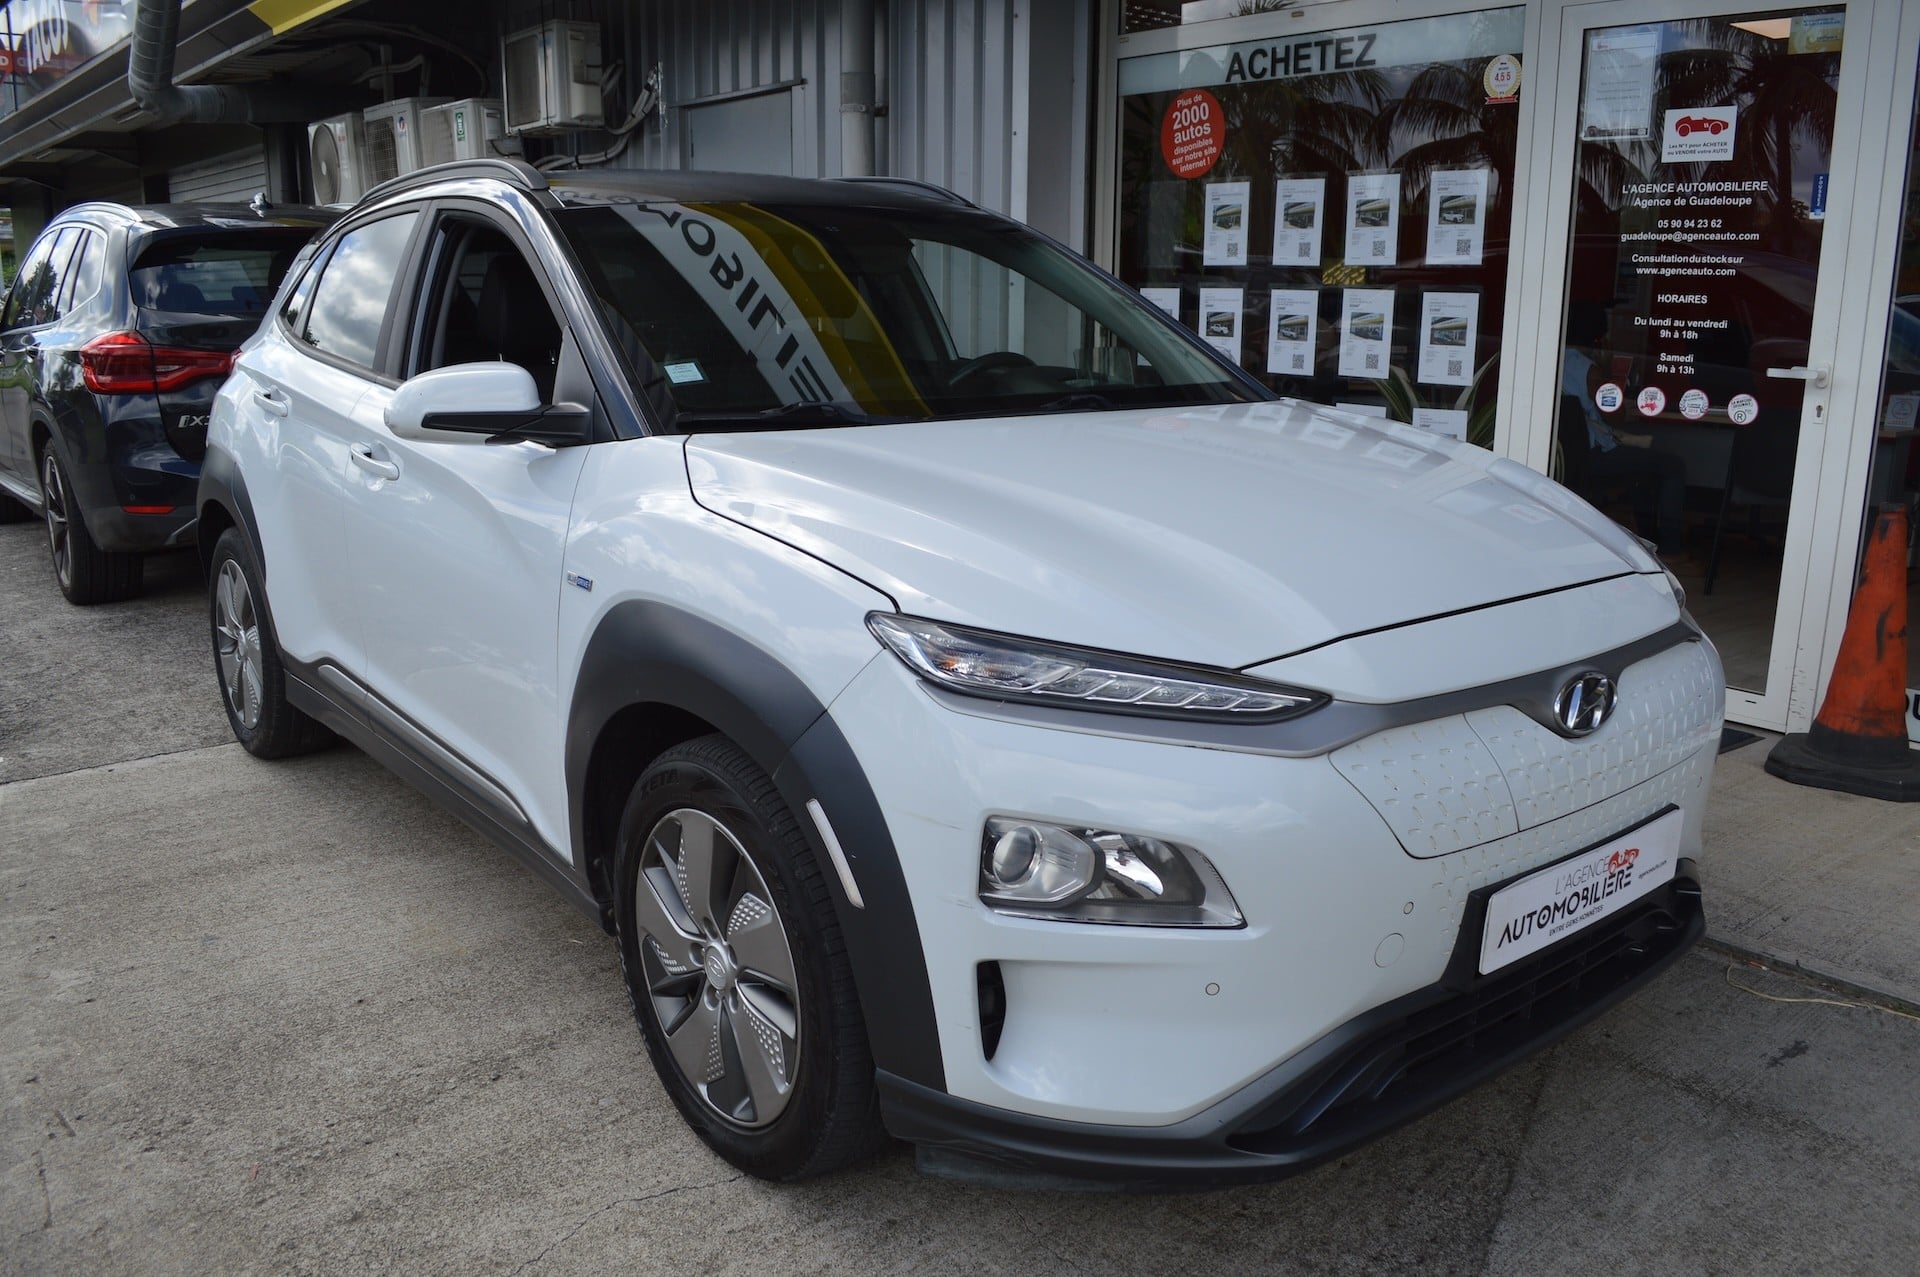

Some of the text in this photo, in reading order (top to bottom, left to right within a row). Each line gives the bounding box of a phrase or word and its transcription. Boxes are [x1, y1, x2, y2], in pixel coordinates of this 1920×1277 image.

[1225, 33, 1377, 83] ACHETEZ
[1177, 94, 1203, 109] Plus de
[1172, 102, 1210, 130] 2000
[1174, 122, 1211, 144] autos
[1174, 137, 1213, 156] disponibles
[1172, 146, 1217, 166] sur notre site
[1180, 158, 1206, 173] internet
[1622, 180, 1769, 194] L'AGENCE AUTOMOBILIERE
[1633, 195, 1752, 209] Agence de Guadeloupe
[1657, 219, 1722, 228] 05 90 94 23 62
[1620, 231, 1760, 243] guadeloupe@agenceauto.com
[1636, 267, 1736, 277] www.agenceauto.com
[1657, 294, 1708, 304] HORAIRES
[1634, 316, 1729, 329] Du lundi au vendredi
[1660, 329, 1698, 340] 9h à 18h
[1660, 352, 1694, 363] Samedi
[1656, 364, 1695, 375] 9h à 13h
[1555, 855, 1611, 895] L'AGENCE
